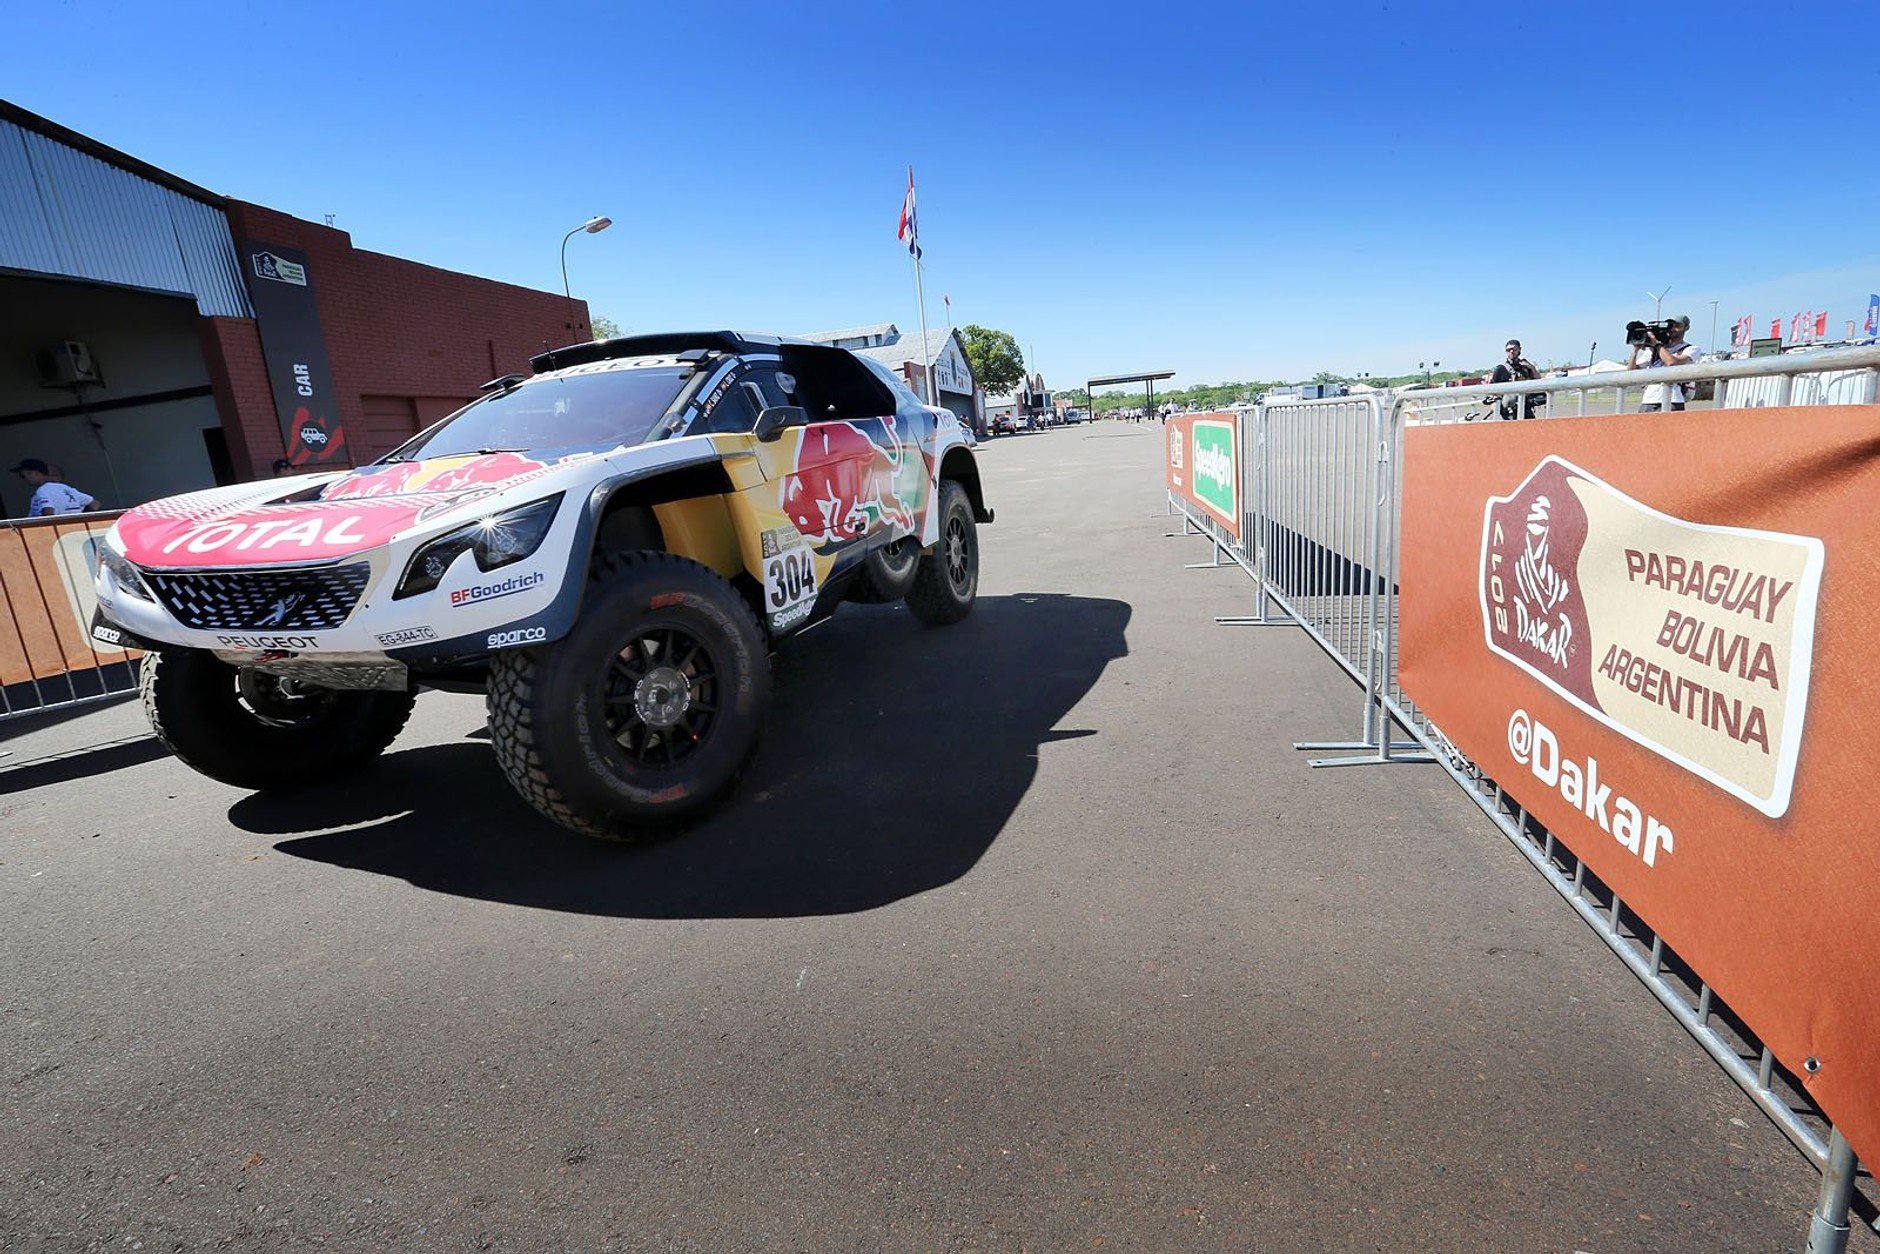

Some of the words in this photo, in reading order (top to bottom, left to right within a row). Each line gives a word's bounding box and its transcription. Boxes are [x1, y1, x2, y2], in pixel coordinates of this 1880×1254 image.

[293, 364, 313, 397] CAR
[162, 516, 366, 554] TOTAL
[450, 572, 544, 604] BFGoodrich
[769, 550, 815, 608] 304
[1624, 548, 1793, 624] PARAGUAY
[93, 626, 120, 642] sparco
[217, 636, 317, 649] PEUGEOT
[378, 628, 434, 646] EG-844-TC
[488, 627, 546, 648] sparco
[1513, 594, 1572, 669] DAKAR
[1656, 608, 1780, 691] BOLIVIA
[1598, 644, 1770, 755] ARGENTINA
[1507, 708, 1674, 868] @Dakar
